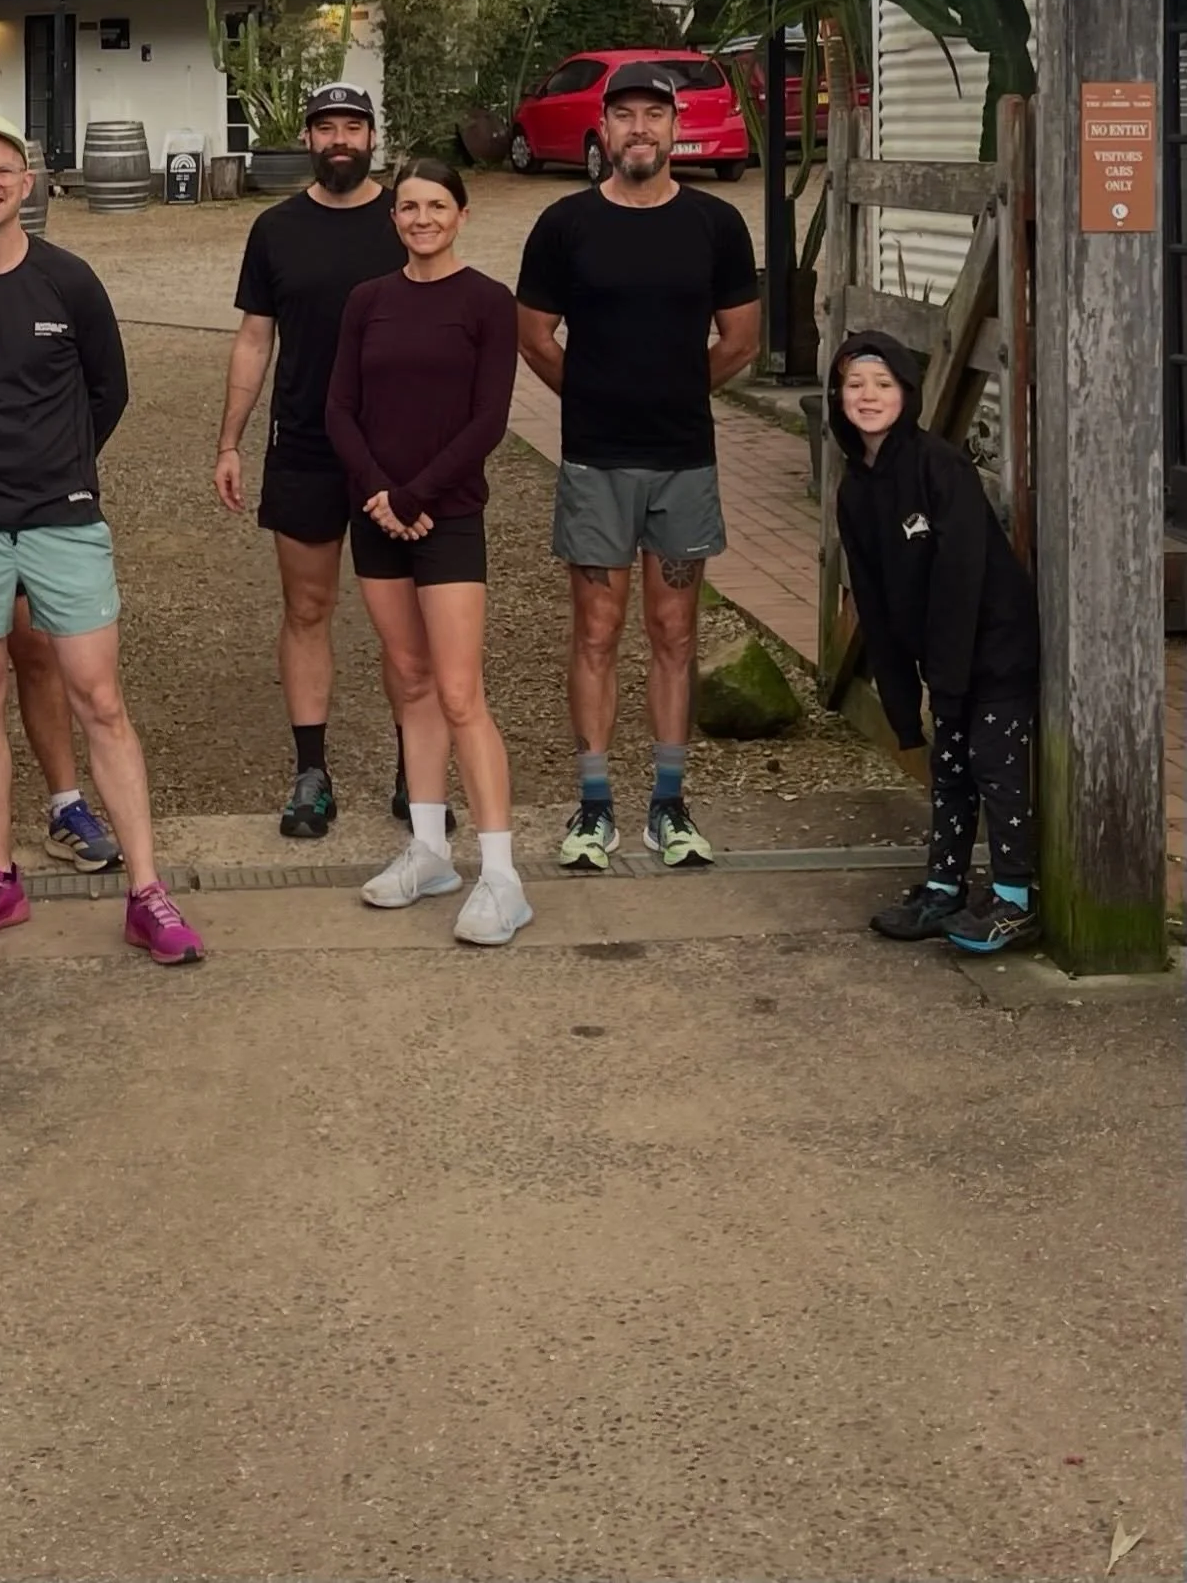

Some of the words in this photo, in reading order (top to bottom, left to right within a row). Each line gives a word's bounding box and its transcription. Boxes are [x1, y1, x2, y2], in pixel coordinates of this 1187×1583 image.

[1091, 124, 1108, 136] NO
[1109, 124, 1147, 136] ENTRY
[1094, 151, 1143, 162] VISITORS
[1105, 165, 1134, 177] CARS
[1105, 180, 1133, 192] ONLY
